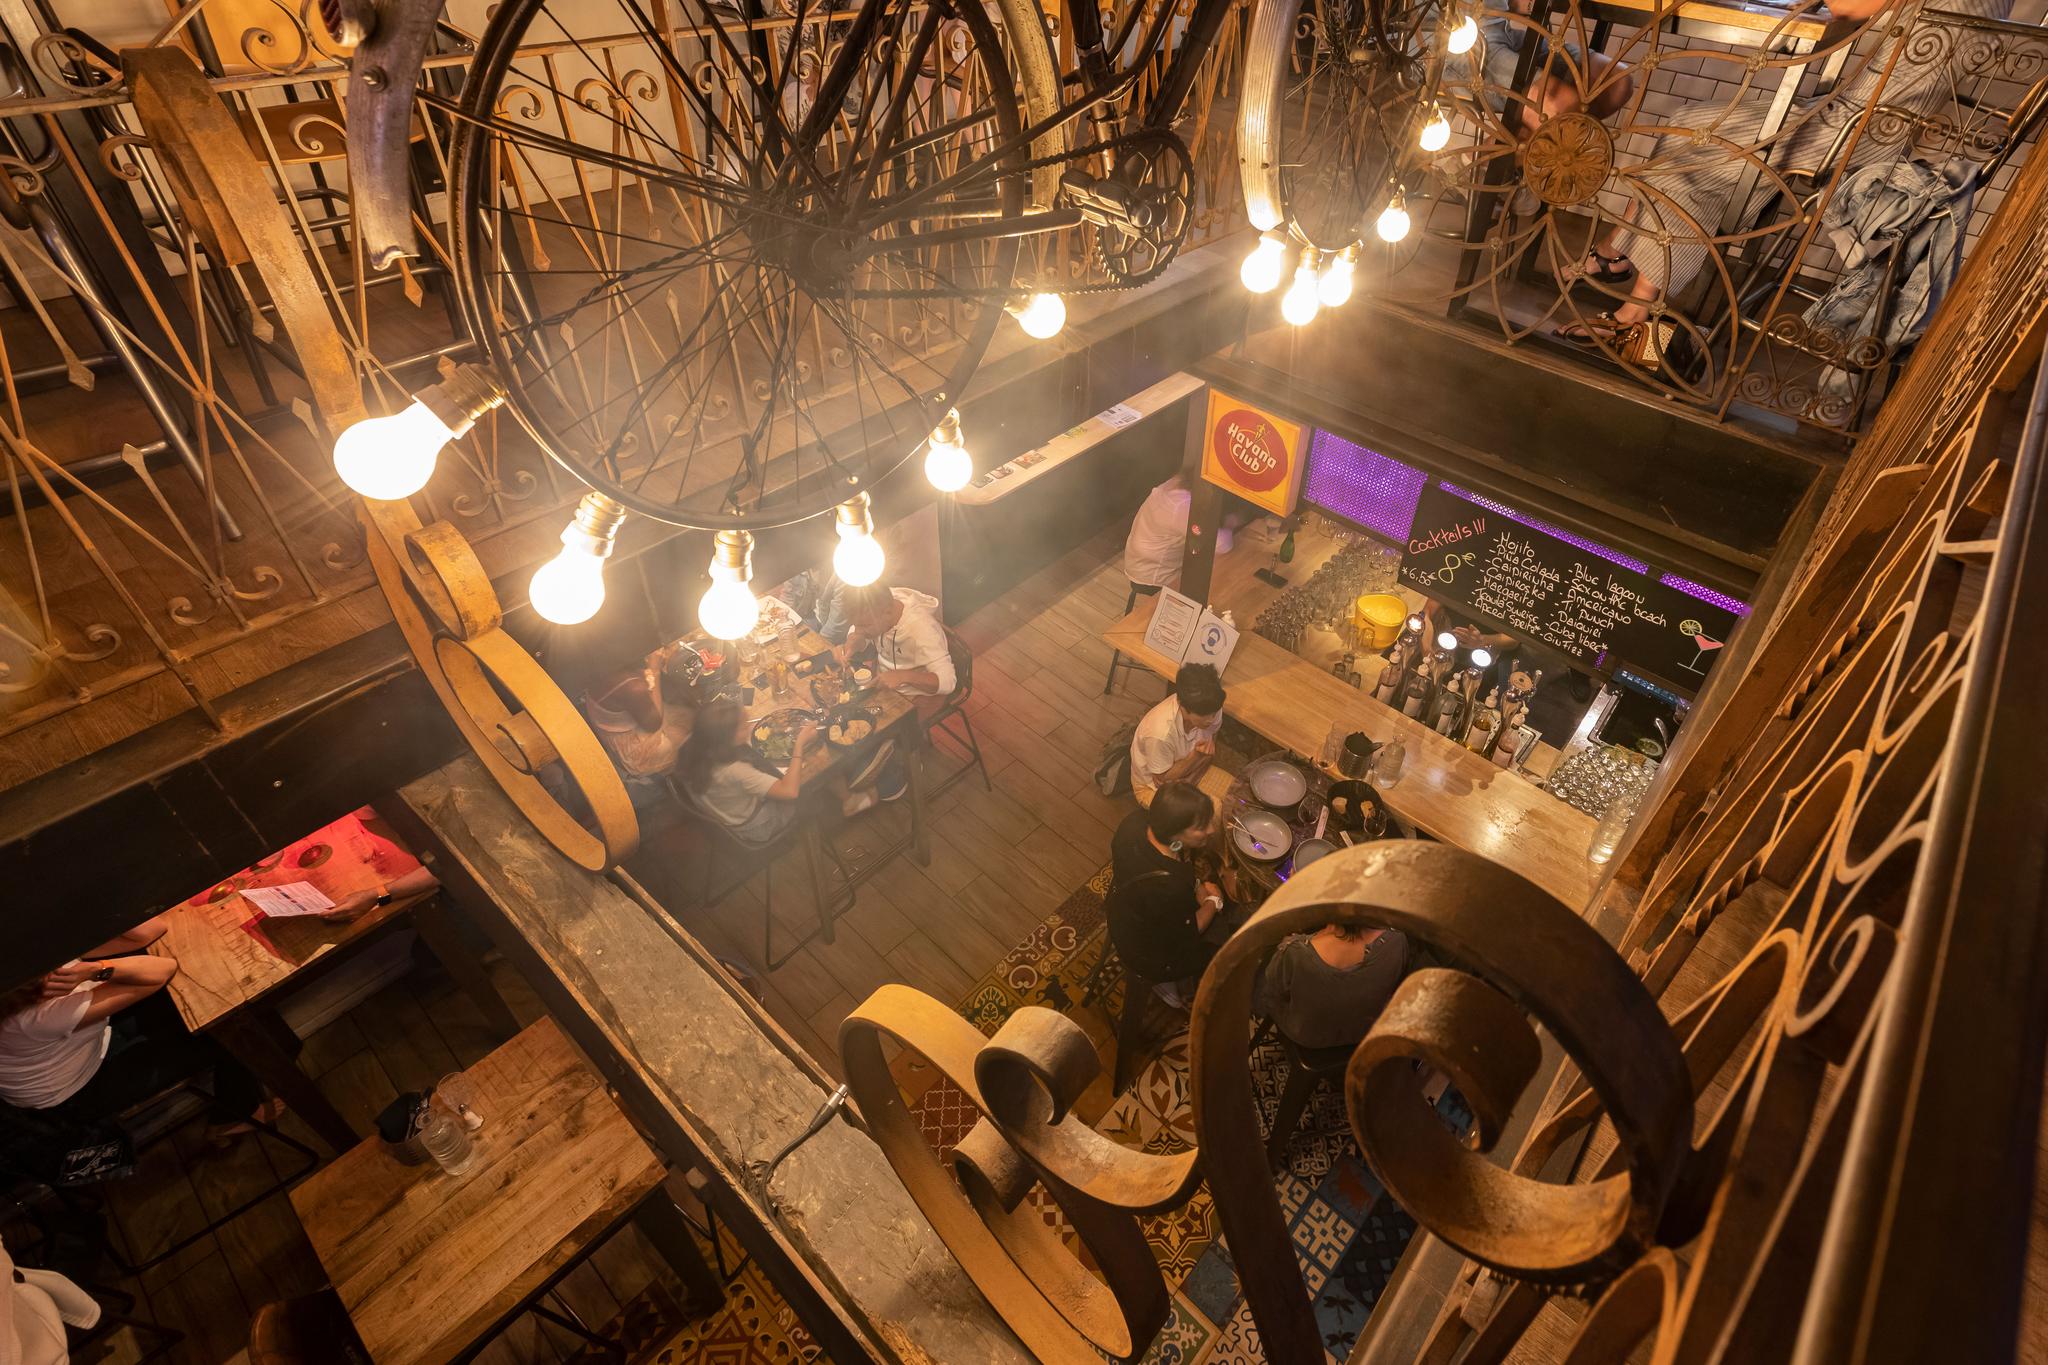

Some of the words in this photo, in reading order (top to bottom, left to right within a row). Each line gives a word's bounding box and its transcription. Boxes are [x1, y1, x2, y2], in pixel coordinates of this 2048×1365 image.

[1227, 422, 1277, 469] Havana
[1232, 443, 1260, 472] Club
[1521, 558, 1560, 583] Colada
[1548, 621, 1576, 640] Cuba
